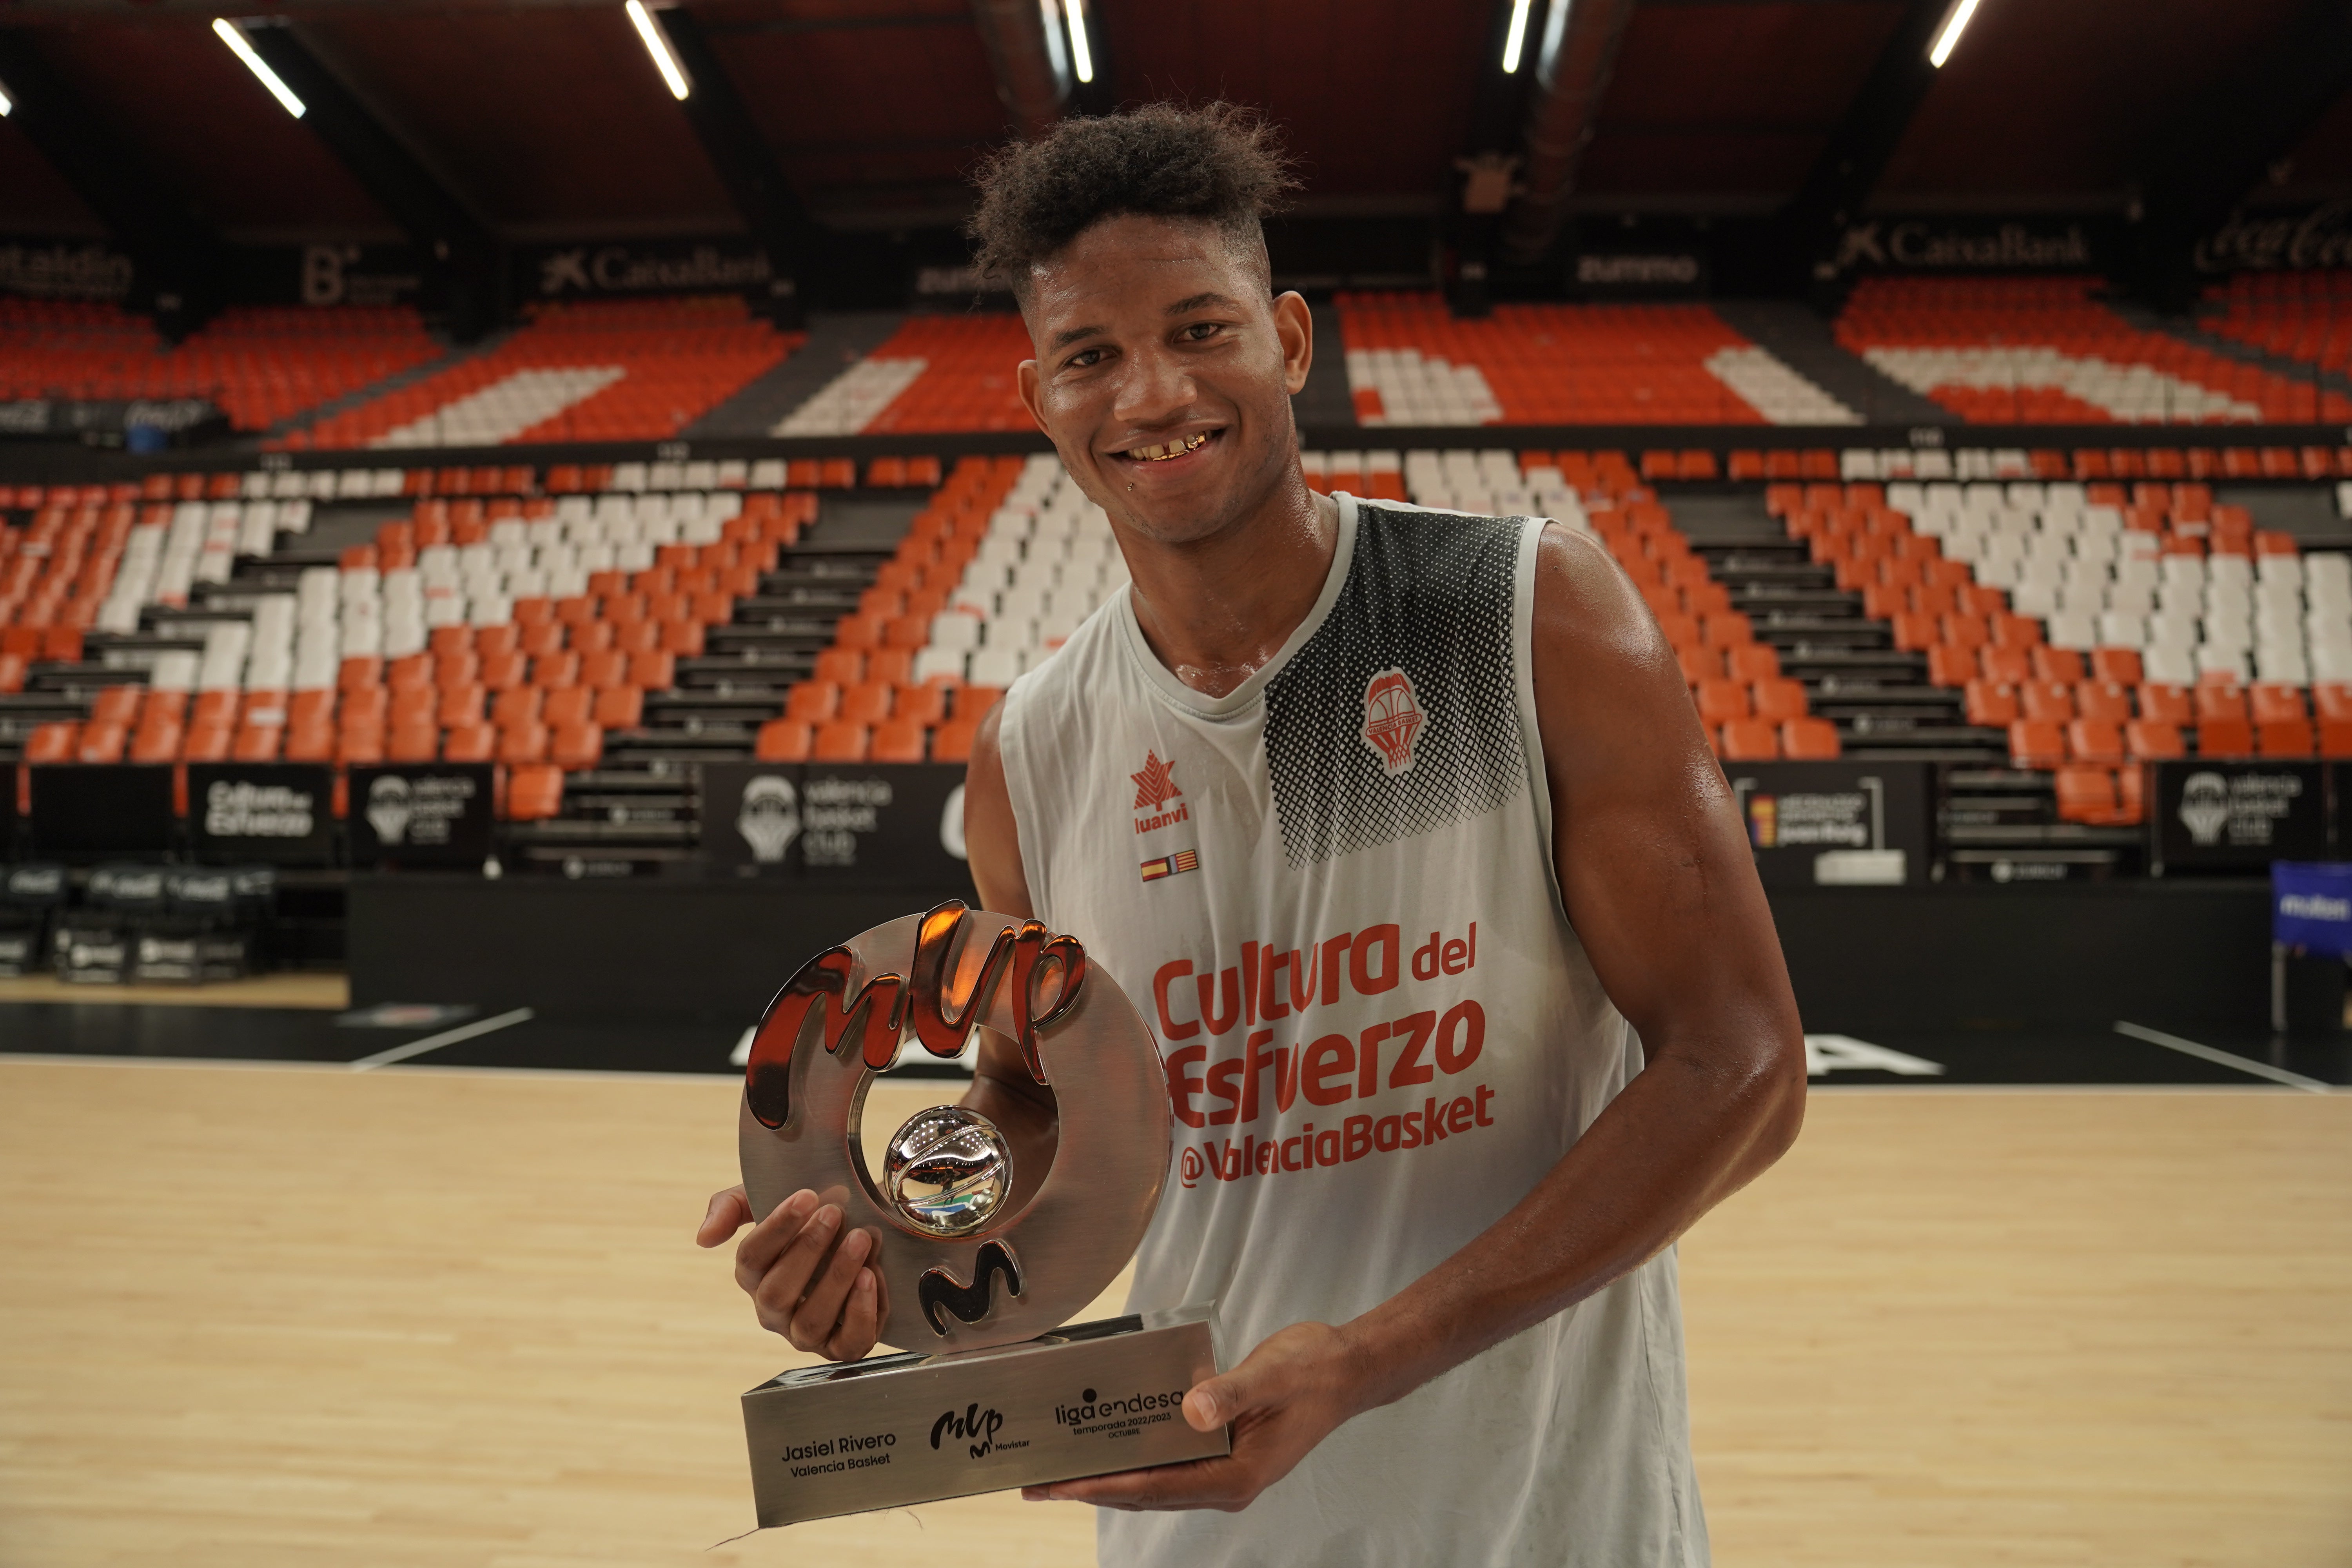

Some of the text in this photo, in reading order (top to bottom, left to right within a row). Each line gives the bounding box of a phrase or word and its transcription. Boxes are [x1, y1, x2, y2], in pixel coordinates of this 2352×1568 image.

[1368, 716, 1418, 734] VALENCIA BASKET
[1135, 803, 1189, 834] luanvi
[1153, 921, 1476, 1041] Cultura del
[1166, 999, 1486, 1128] Esfuerzo
[1180, 1084, 1494, 1188] @ValenciaBasket
[1073, 1412, 1172, 1436] temporada 2022/2023
[1108, 1428, 1141, 1438] OCTUBRE
[782, 1433, 897, 1462] Jasiel Rivero
[995, 1440, 1030, 1451] Movistar
[791, 1452, 891, 1477] Valencia Basket
